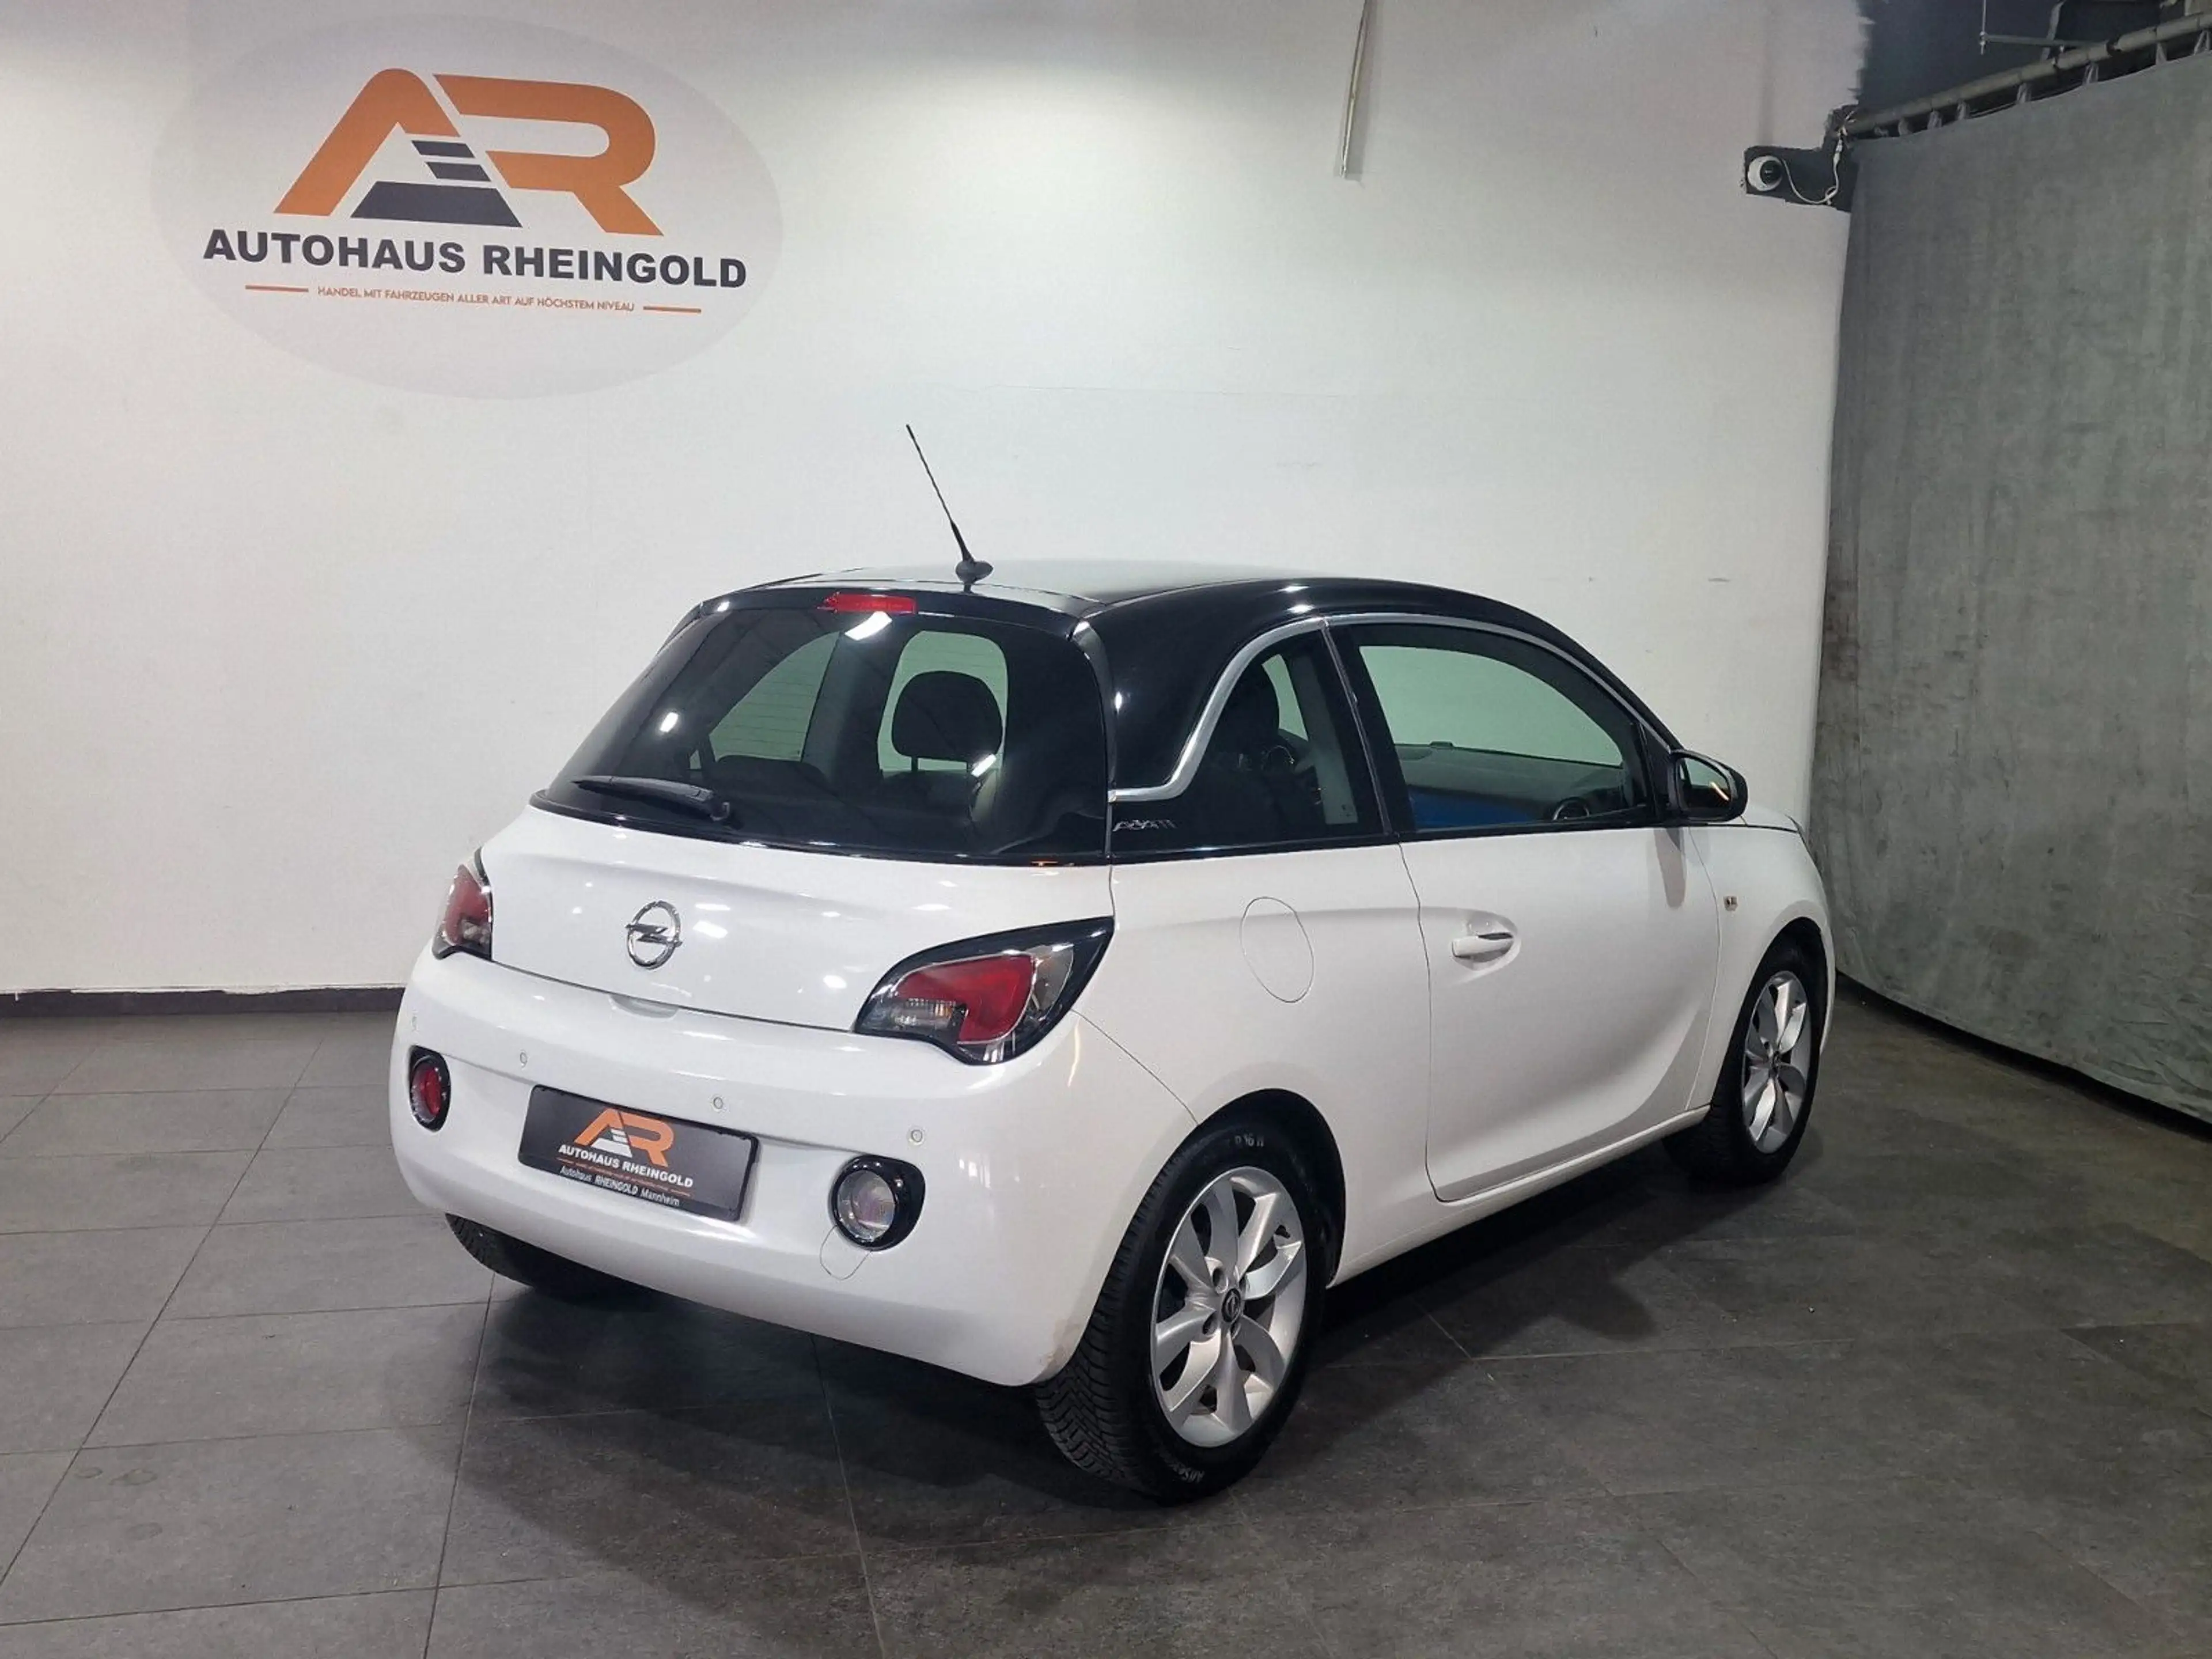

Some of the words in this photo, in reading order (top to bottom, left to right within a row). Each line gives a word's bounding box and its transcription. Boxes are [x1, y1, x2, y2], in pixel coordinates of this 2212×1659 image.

[203, 228, 466, 274] AUTOHAUS
[483, 244, 747, 289] RHEINGOLD
[317, 286, 362, 298] HANDEL
[363, 289, 382, 298] MIT
[384, 289, 455, 302] FAHRZEUGEN
[456, 293, 490, 304] ALLER
[491, 296, 512, 305] ART
[514, 296, 535, 306] AUF
[537, 297, 594, 310] HÖCHSTEM
[597, 300, 634, 312] NIVEAU
[558, 1144, 620, 1169] AUTOHAUS
[622, 1161, 694, 1188] RHEINGOLD
[559, 1165, 593, 1181] Autohaus
[594, 1175, 638, 1196] RHEINGOLD
[640, 1187, 680, 1207] Mannheim
